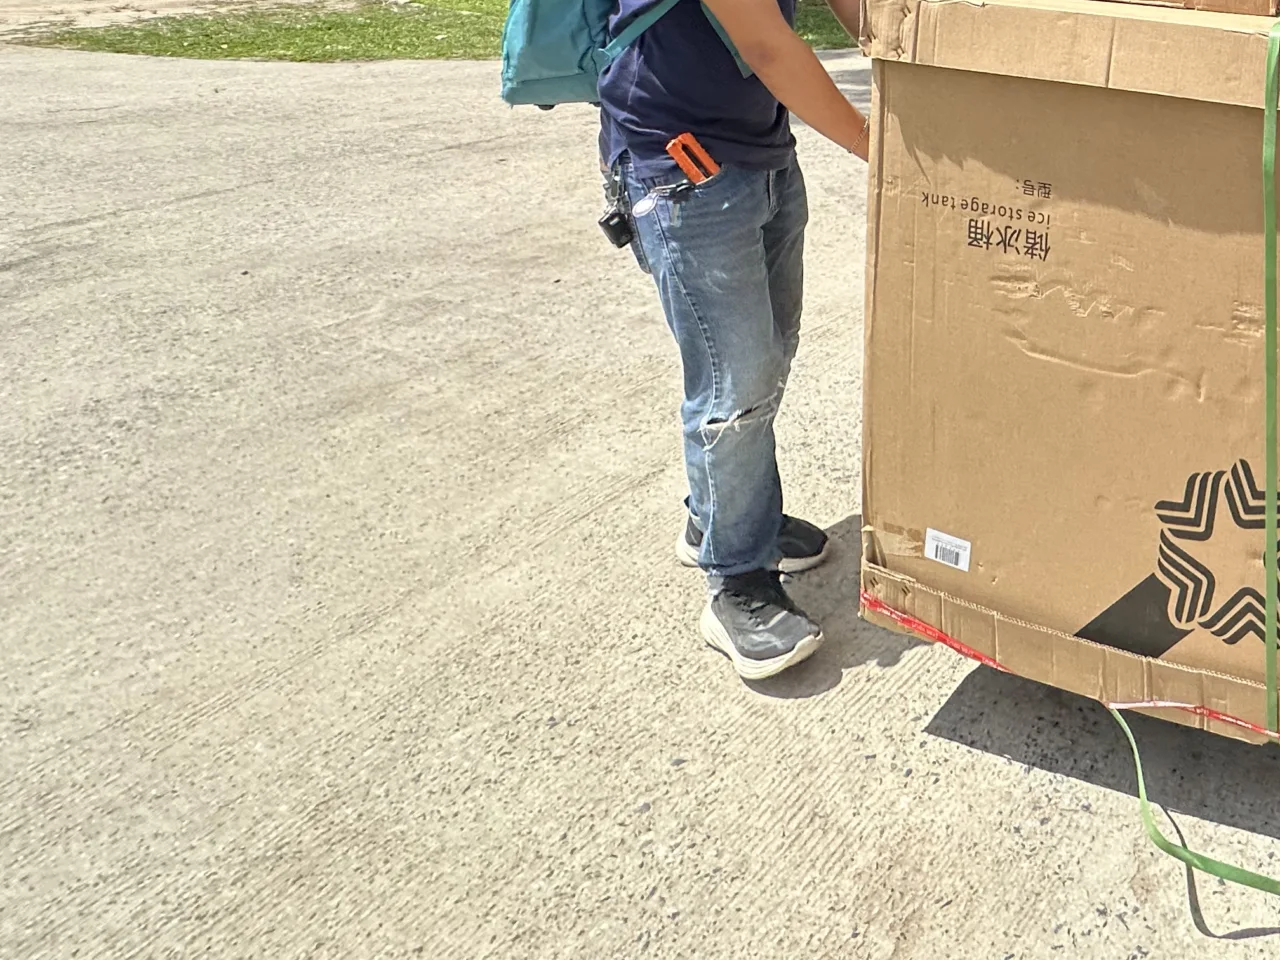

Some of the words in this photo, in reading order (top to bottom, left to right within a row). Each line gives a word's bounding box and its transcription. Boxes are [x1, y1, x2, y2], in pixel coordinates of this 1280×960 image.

[921, 191, 956, 211] tank
[960, 197, 1023, 222] storage
[1027, 211, 1051, 230] ice
[967, 218, 1051, 262] 储冰桶
